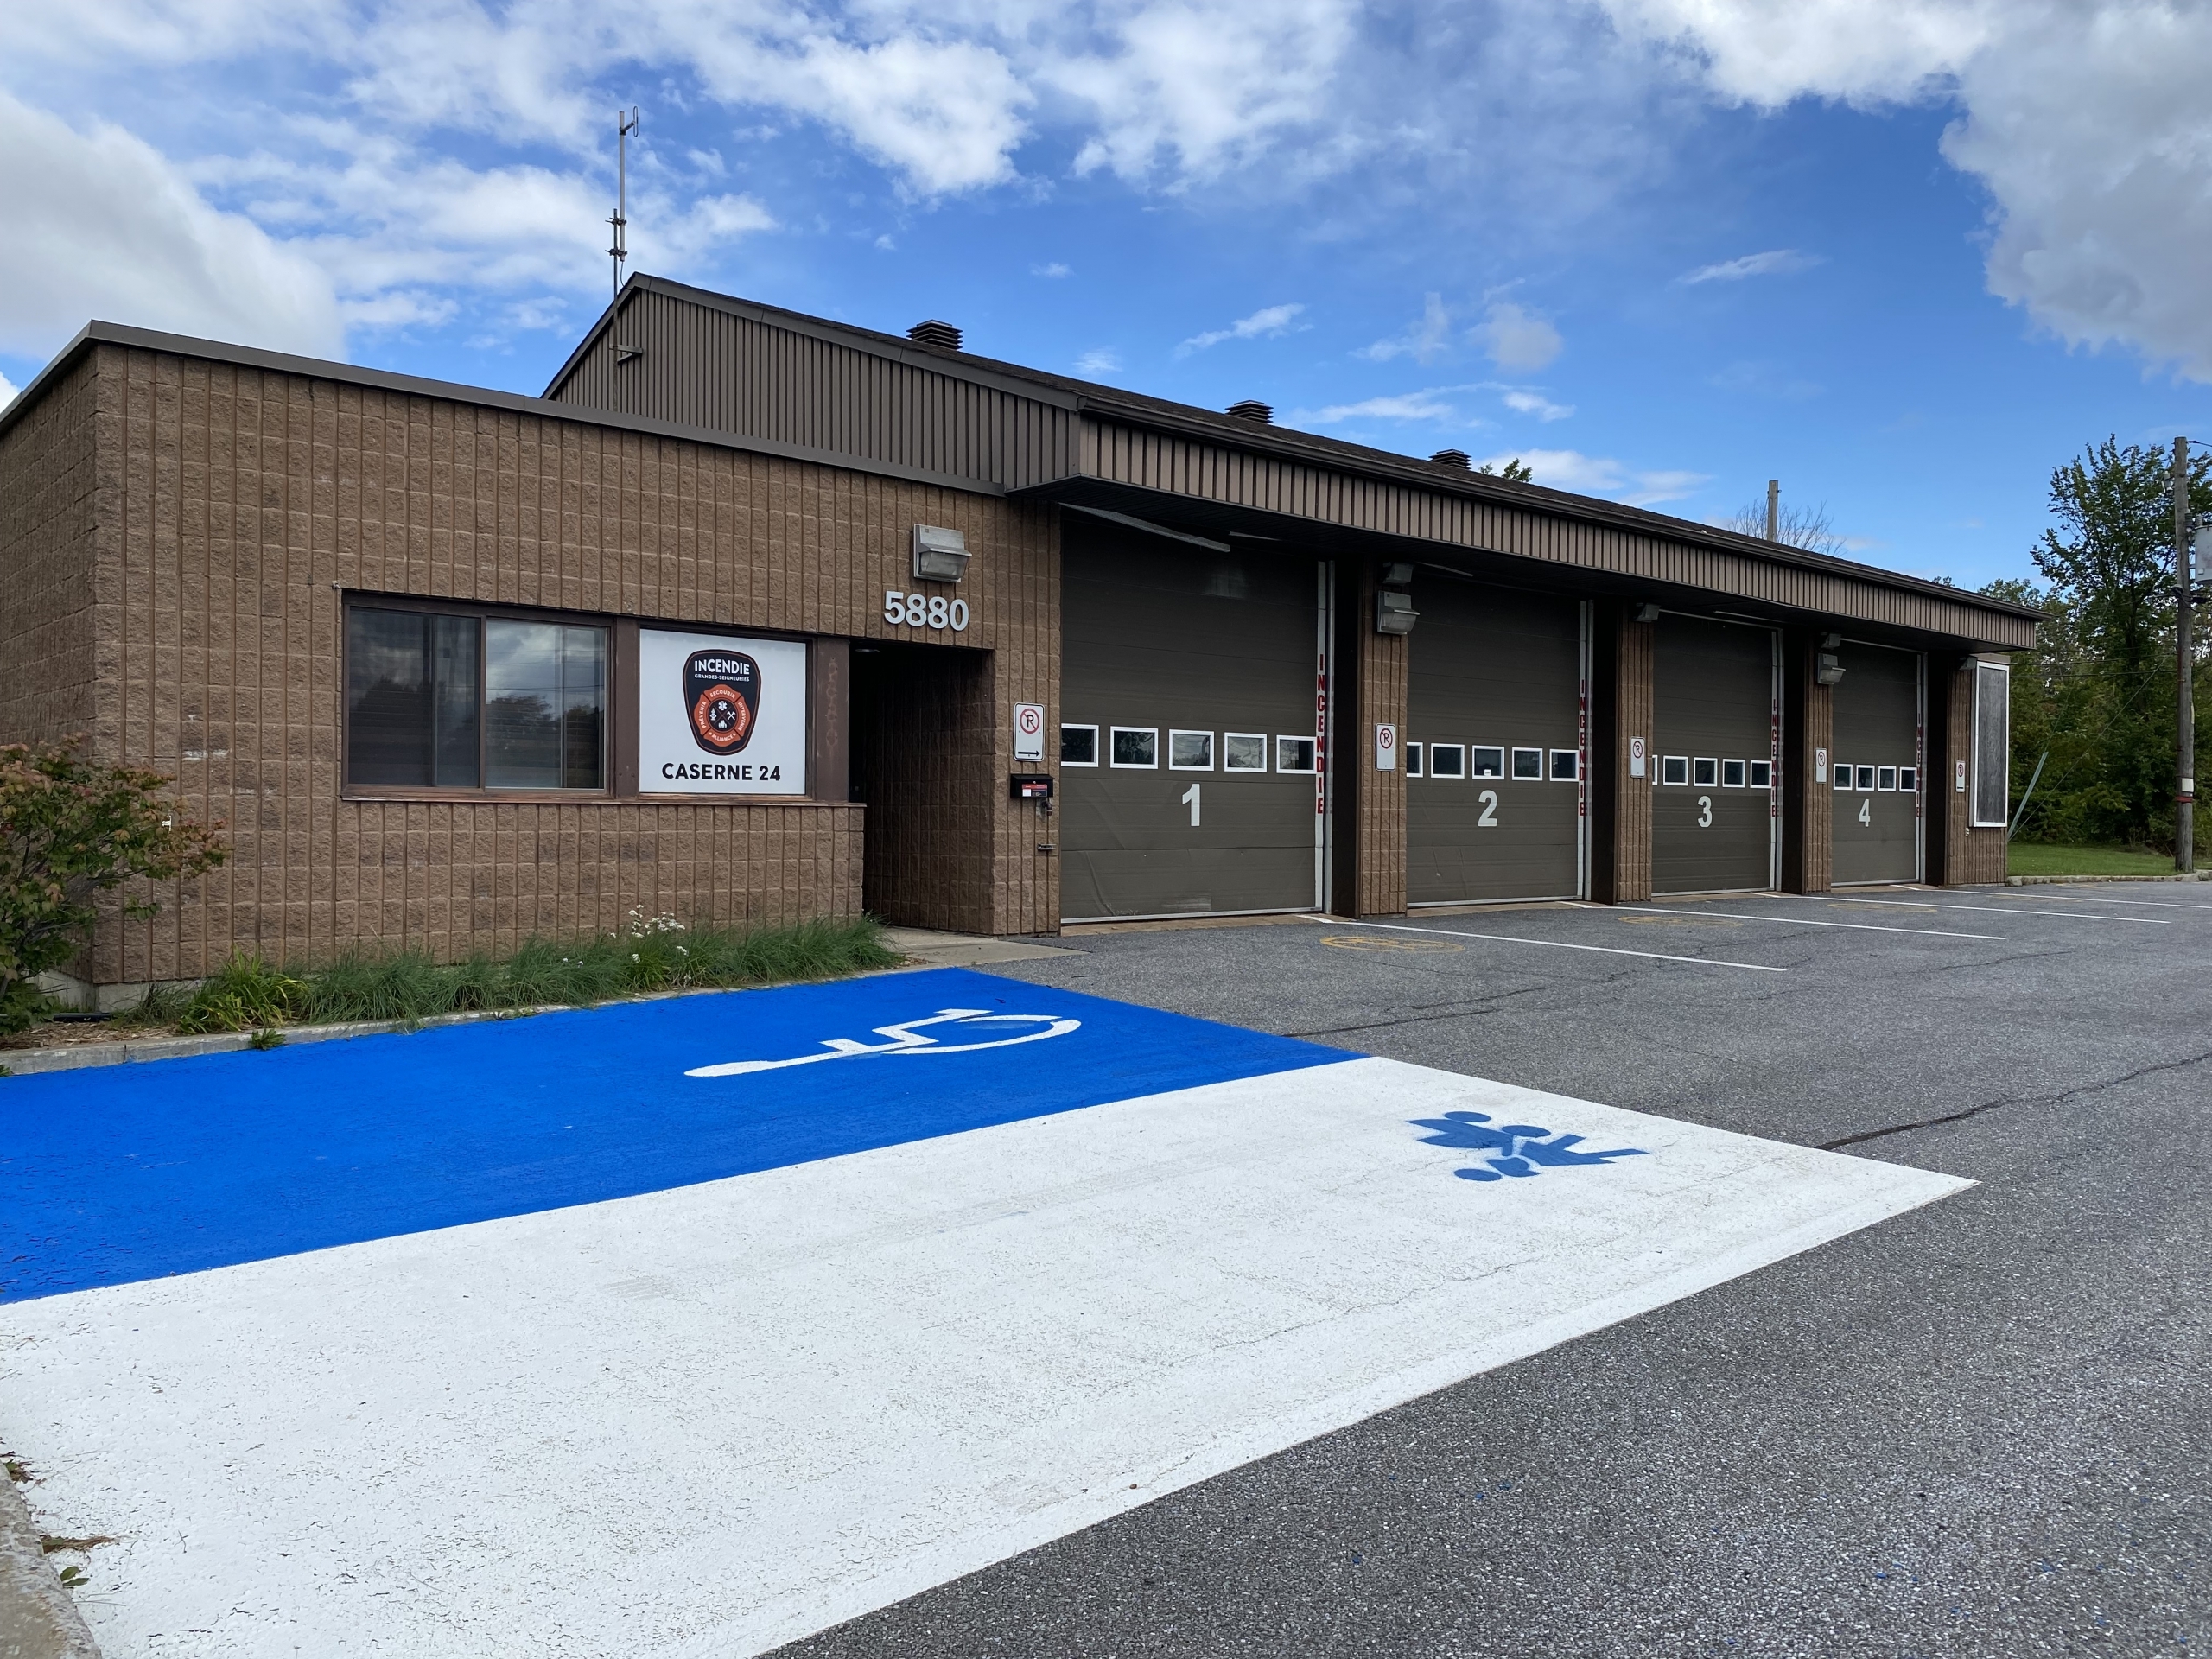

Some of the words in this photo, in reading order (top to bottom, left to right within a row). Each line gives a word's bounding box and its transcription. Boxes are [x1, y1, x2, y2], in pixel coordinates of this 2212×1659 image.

[884, 590, 969, 632] 5880
[694, 658, 750, 674] INCENDIE
[694, 673, 750, 682] GRANDES-SEIGNEURIES
[710, 690, 735, 698] SECOURIR
[1317, 654, 1325, 814] INCENDIE
[662, 762, 753, 781] CASERNE
[759, 765, 781, 781] 24
[1182, 783, 1201, 827] 1
[1477, 789, 1498, 827] 2
[1697, 795, 1713, 828] 3
[1859, 798, 1871, 827] 4
